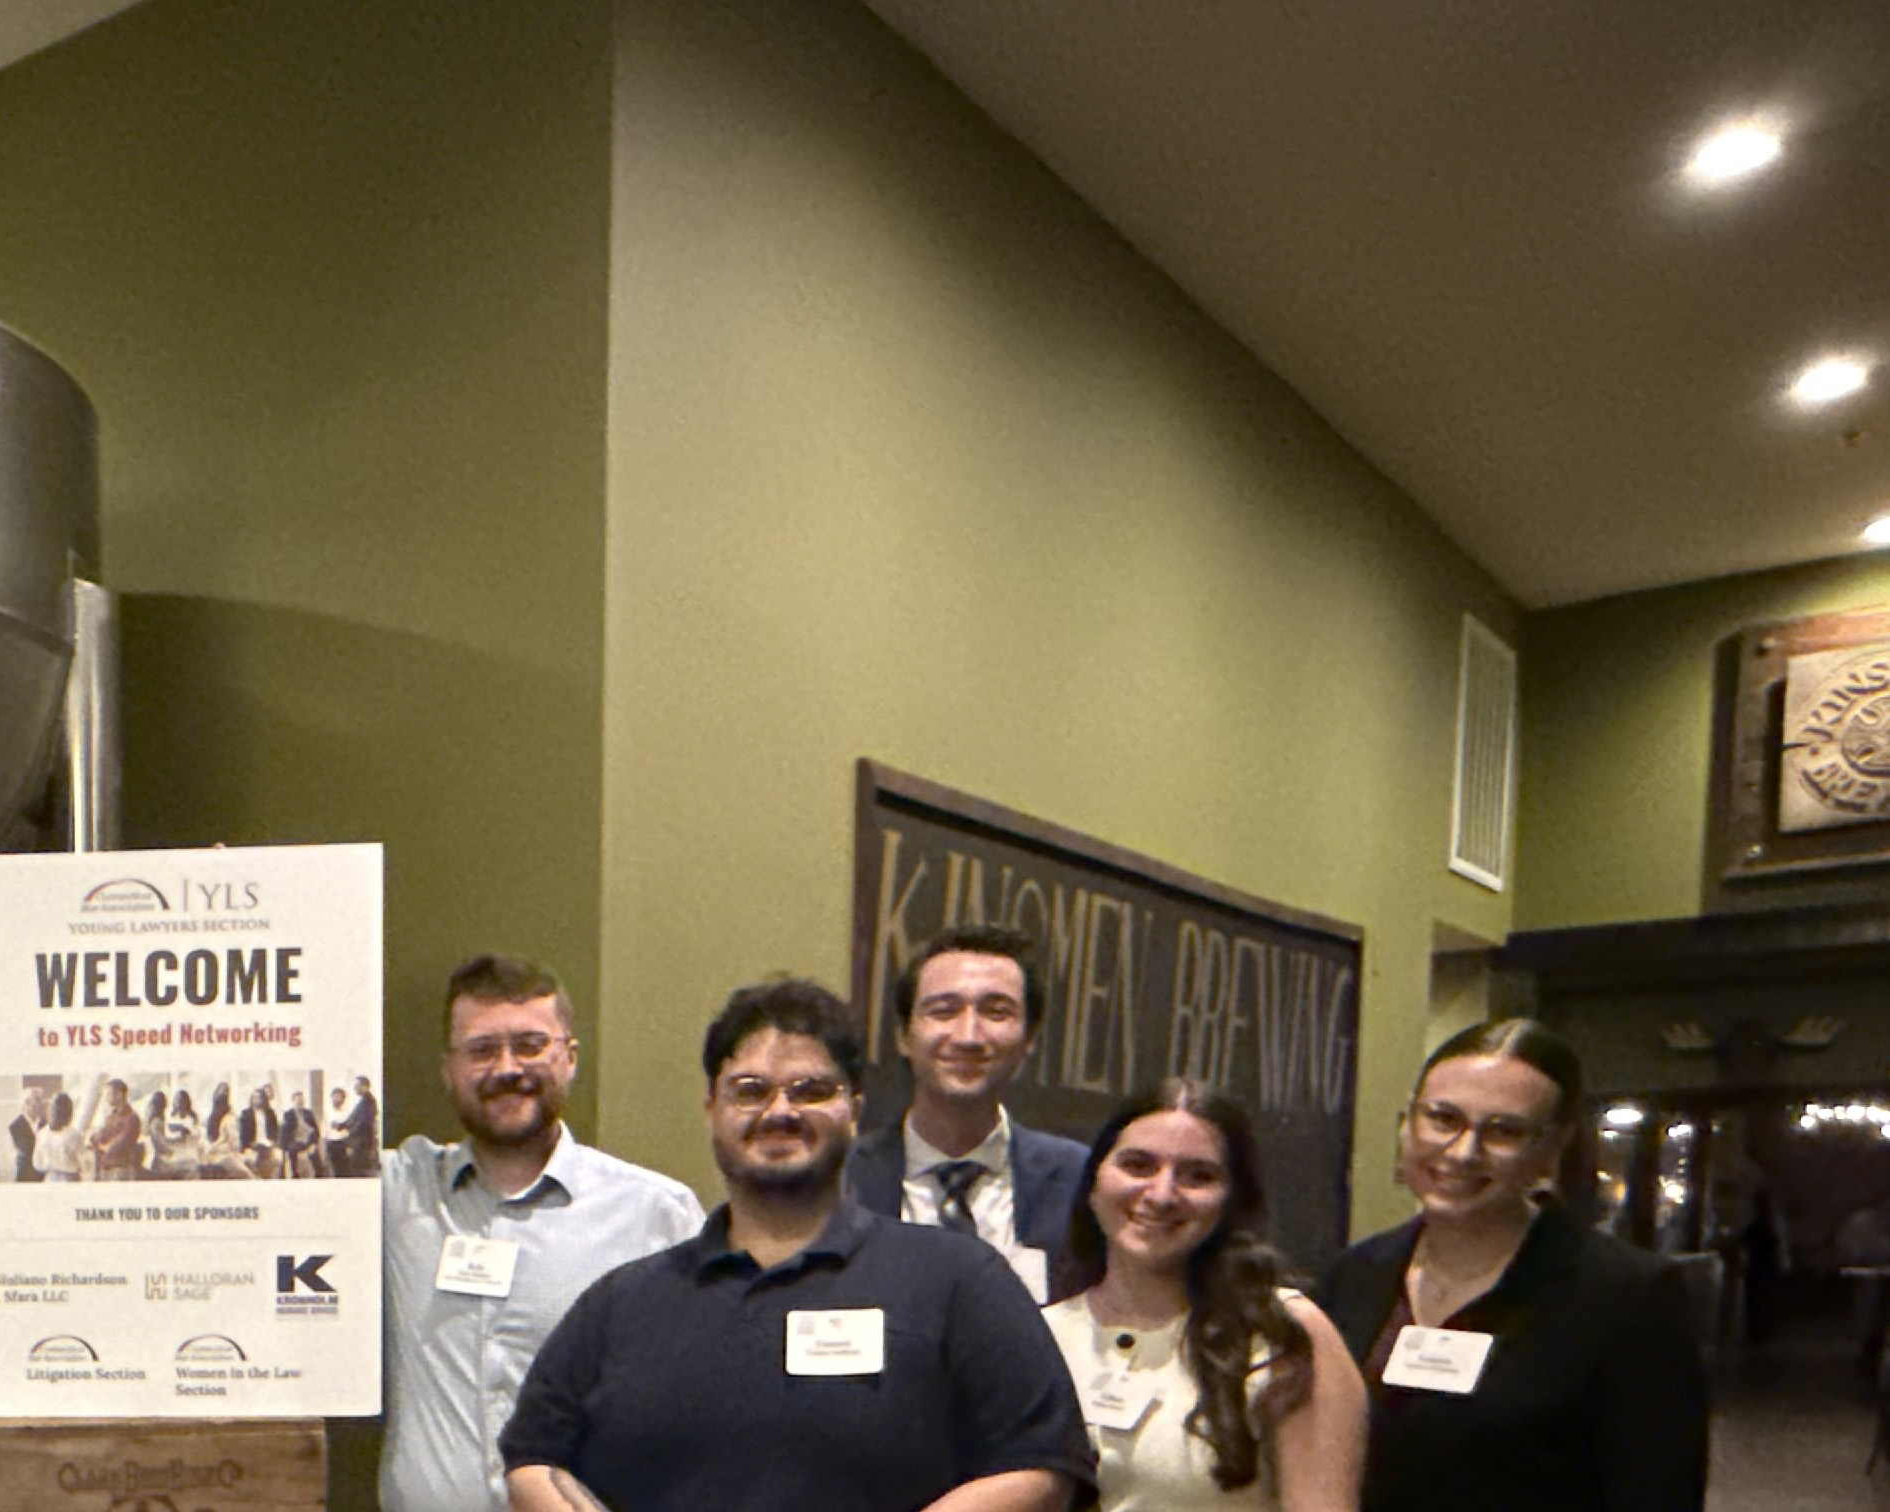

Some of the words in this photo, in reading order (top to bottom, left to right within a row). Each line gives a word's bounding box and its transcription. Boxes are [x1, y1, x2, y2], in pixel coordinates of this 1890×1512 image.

[197, 882, 260, 911] YLS
[67, 921, 126, 936] YOUNG
[130, 919, 198, 934] LAWYERS
[202, 917, 271, 933] SECTION
[35, 948, 302, 1008] WELCOME
[38, 1027, 59, 1047] to
[66, 1025, 103, 1046] YLS
[110, 1024, 172, 1049] Speed
[180, 1022, 301, 1047] Networking
[75, 1208, 114, 1221] THANK
[119, 1207, 142, 1221] YOU
[146, 1207, 161, 1220] TO
[165, 1207, 190, 1220] OUR
[194, 1206, 259, 1220] SPONSORS
[51, 1273, 127, 1286] Richardson
[174, 1273, 255, 1286] HALLORAN
[42, 1290, 69, 1302] LLC
[174, 1287, 211, 1301] SAGE
[26, 1368, 92, 1383] Litigation
[95, 1367, 146, 1380] Section
[175, 1366, 226, 1379] Women
[230, 1366, 244, 1379] in
[248, 1366, 269, 1379] the
[274, 1367, 301, 1379] Law
[175, 1384, 226, 1397] Section
